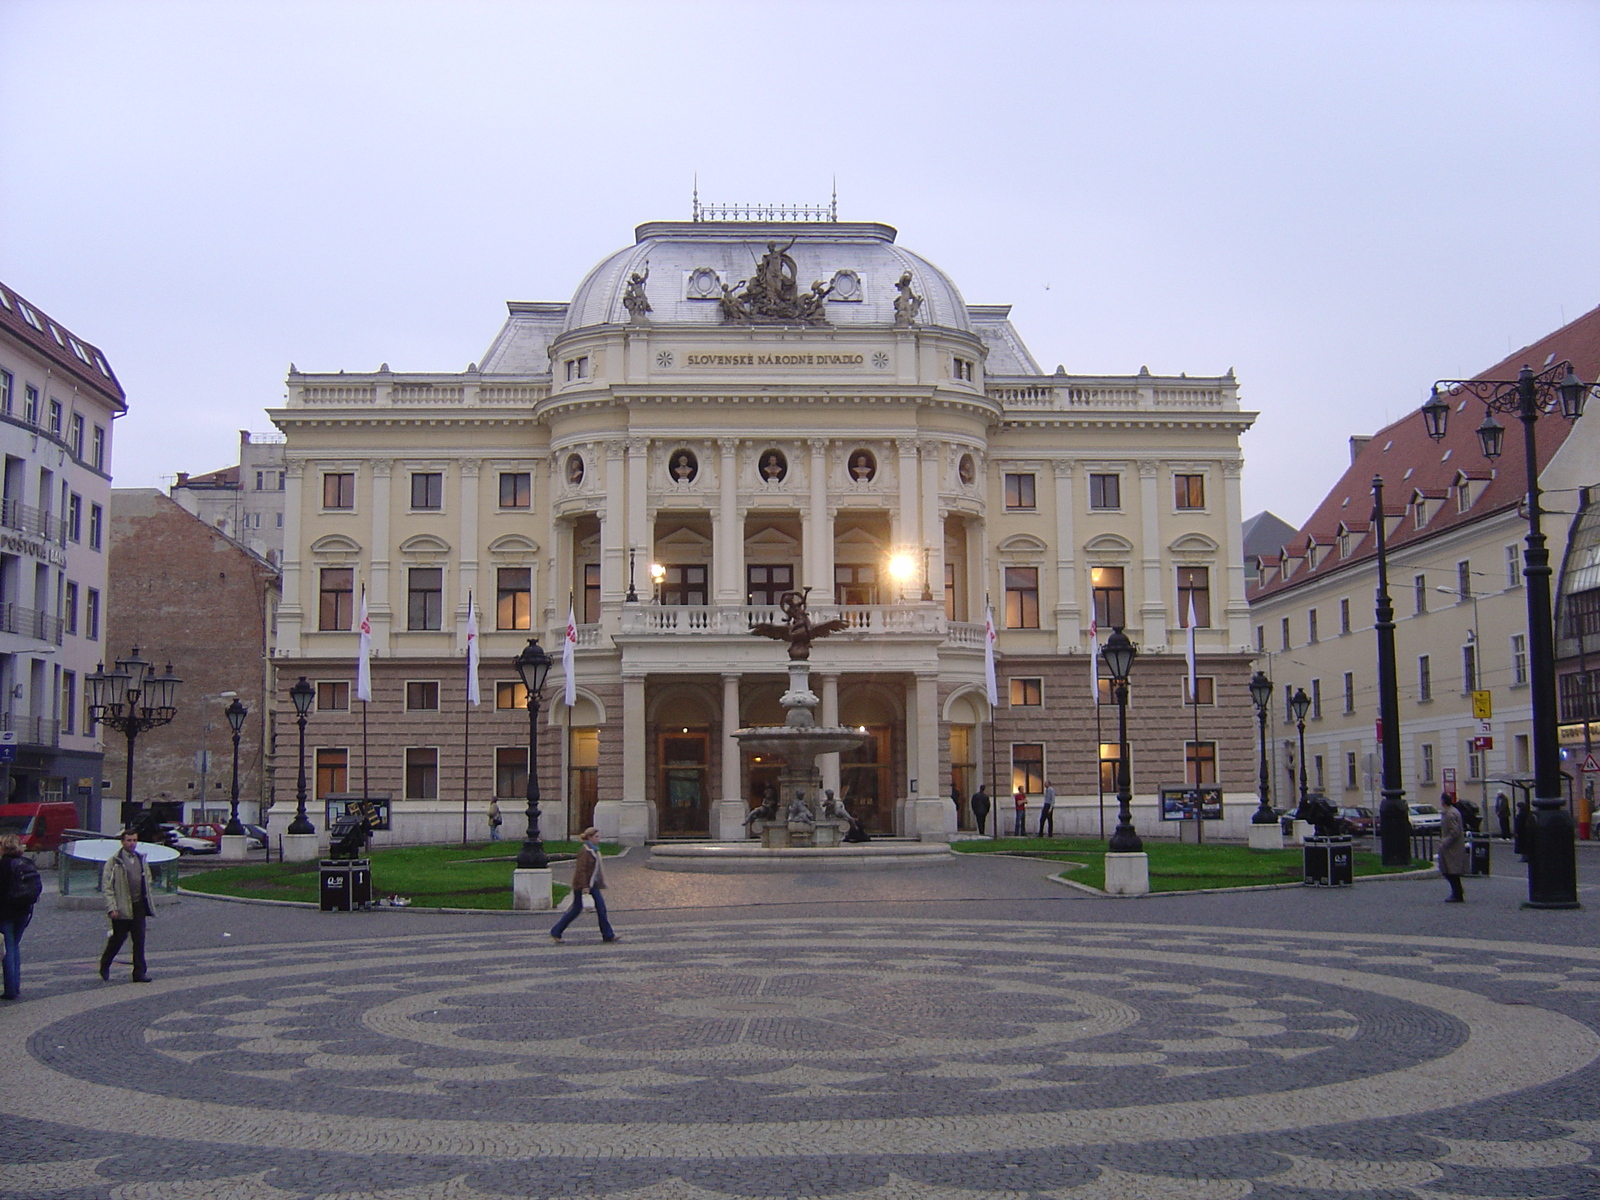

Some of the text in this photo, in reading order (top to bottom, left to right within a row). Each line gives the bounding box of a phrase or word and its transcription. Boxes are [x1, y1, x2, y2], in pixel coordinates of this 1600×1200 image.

[687, 352, 864, 366] SLOVENSKÉ NÁRODNÉ DIVADLO
